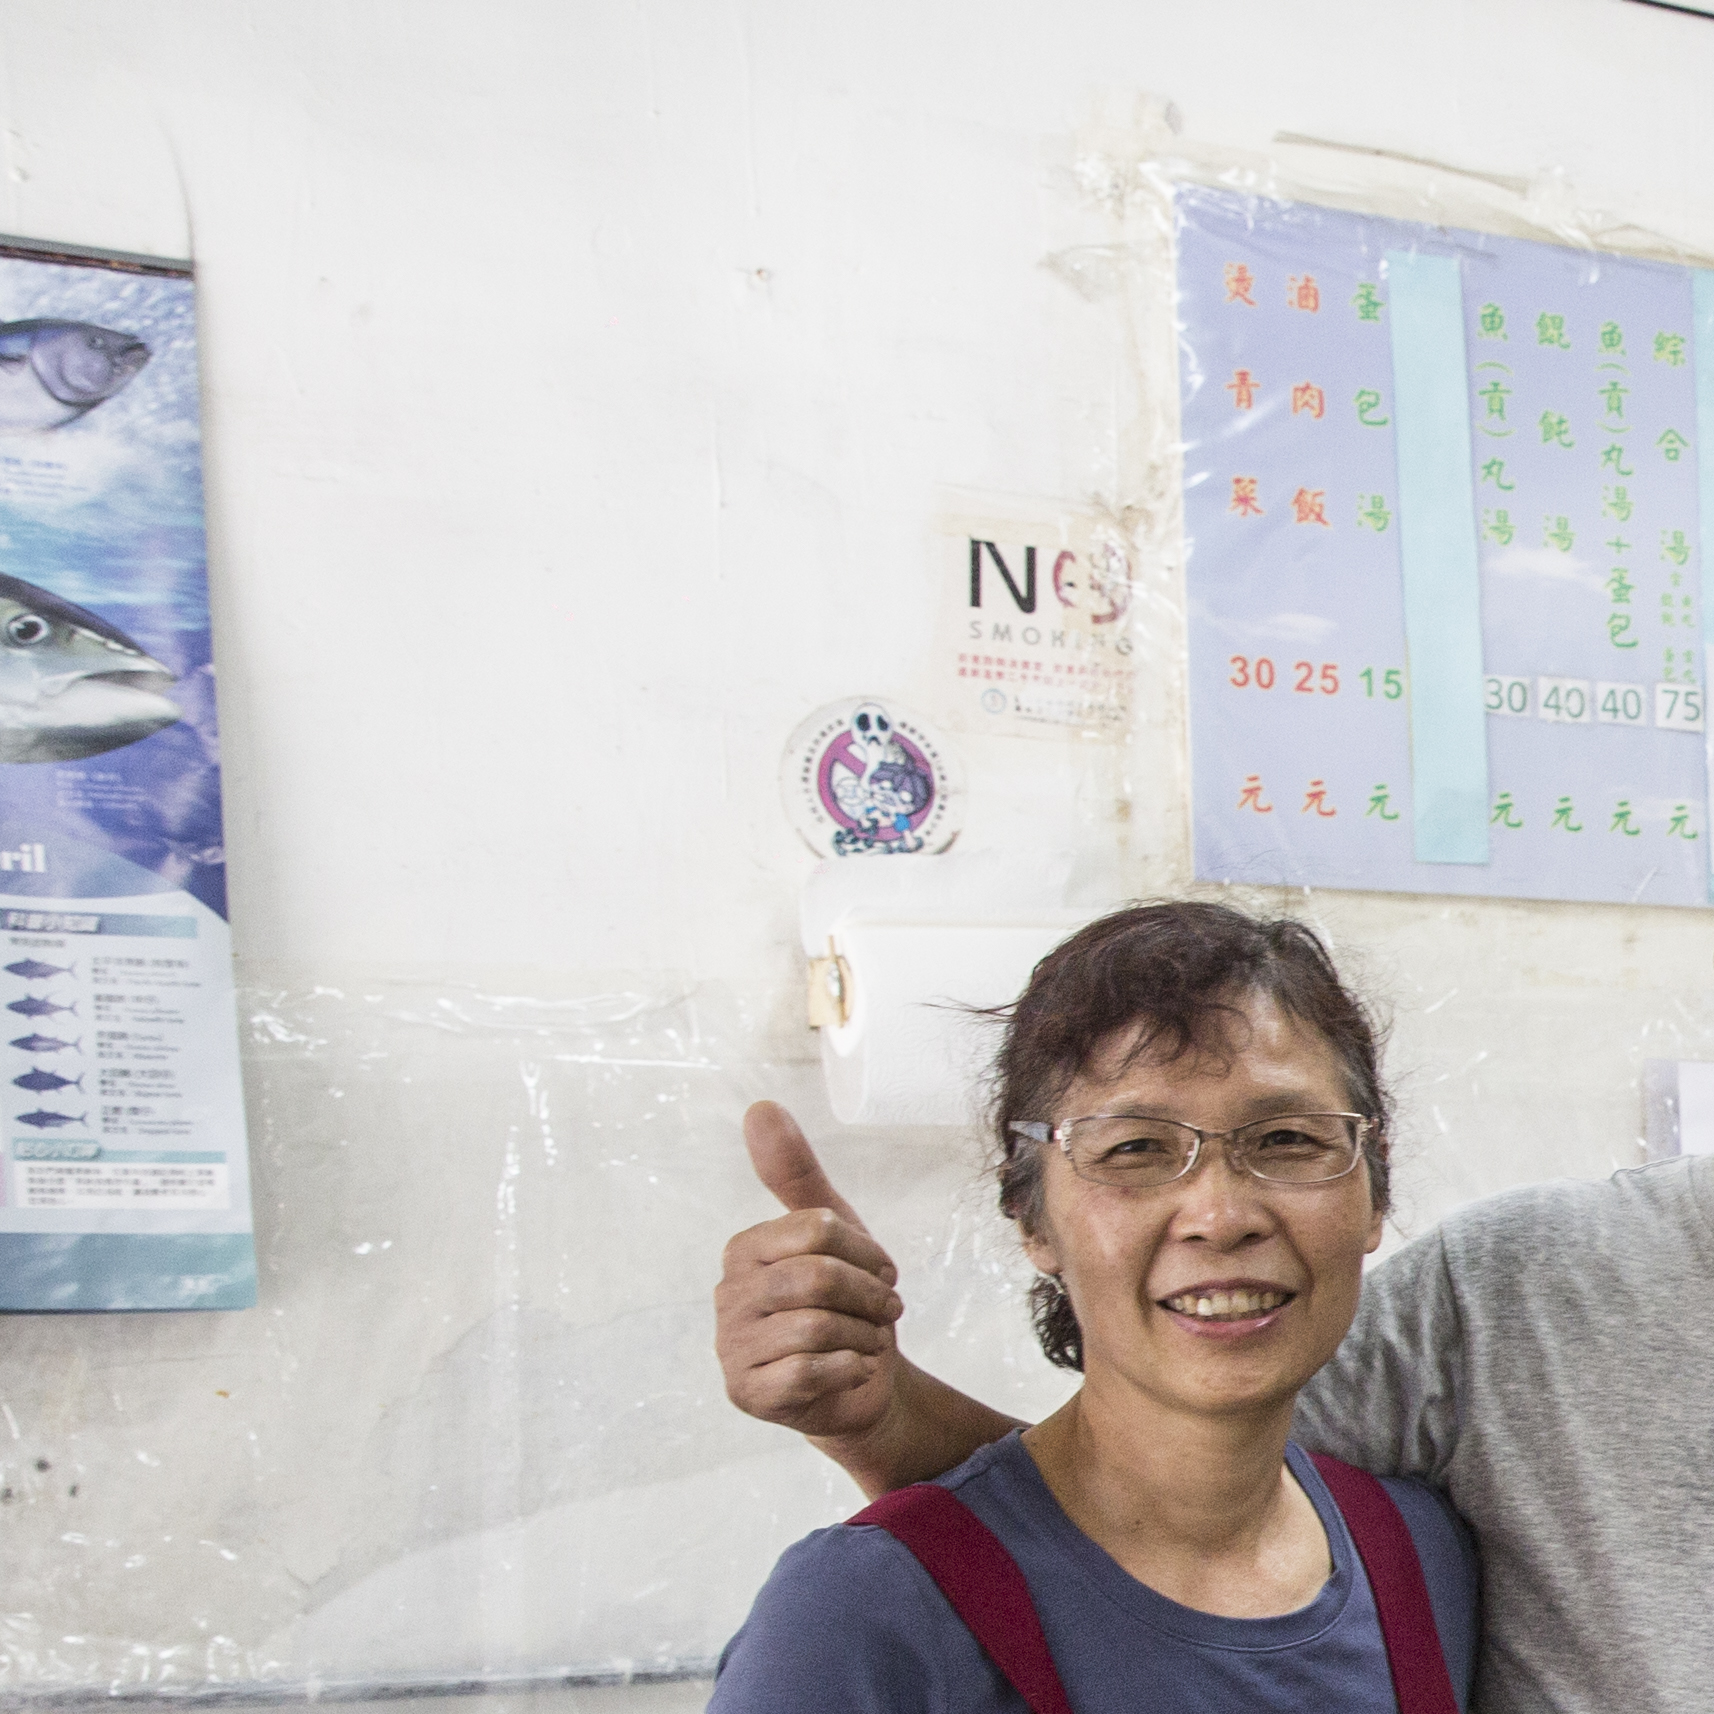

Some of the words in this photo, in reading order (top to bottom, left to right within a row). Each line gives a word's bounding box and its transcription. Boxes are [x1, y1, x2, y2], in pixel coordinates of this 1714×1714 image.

[1223, 261, 1265, 519] 燙青菜
[1286, 274, 1332, 529] 滷肉飯
[1350, 281, 1393, 533] 蛋包湯
[1534, 311, 1577, 554] 餛飩湯
[1652, 330, 1693, 567] 綜合湯
[1229, 654, 1277, 691] 30
[1293, 659, 1341, 696] 25
[1358, 666, 1402, 701] 15
[1485, 678, 1529, 715] 30
[1543, 685, 1587, 721] 40
[1601, 688, 1643, 722] 40
[1663, 688, 1703, 724] 75
[1237, 774, 1274, 815] 元
[1302, 779, 1338, 819] 元
[1366, 783, 1401, 823] 元
[1491, 791, 1525, 831] 元
[1551, 795, 1585, 834] 元
[1609, 799, 1643, 838] 元
[1666, 803, 1700, 842] 元
